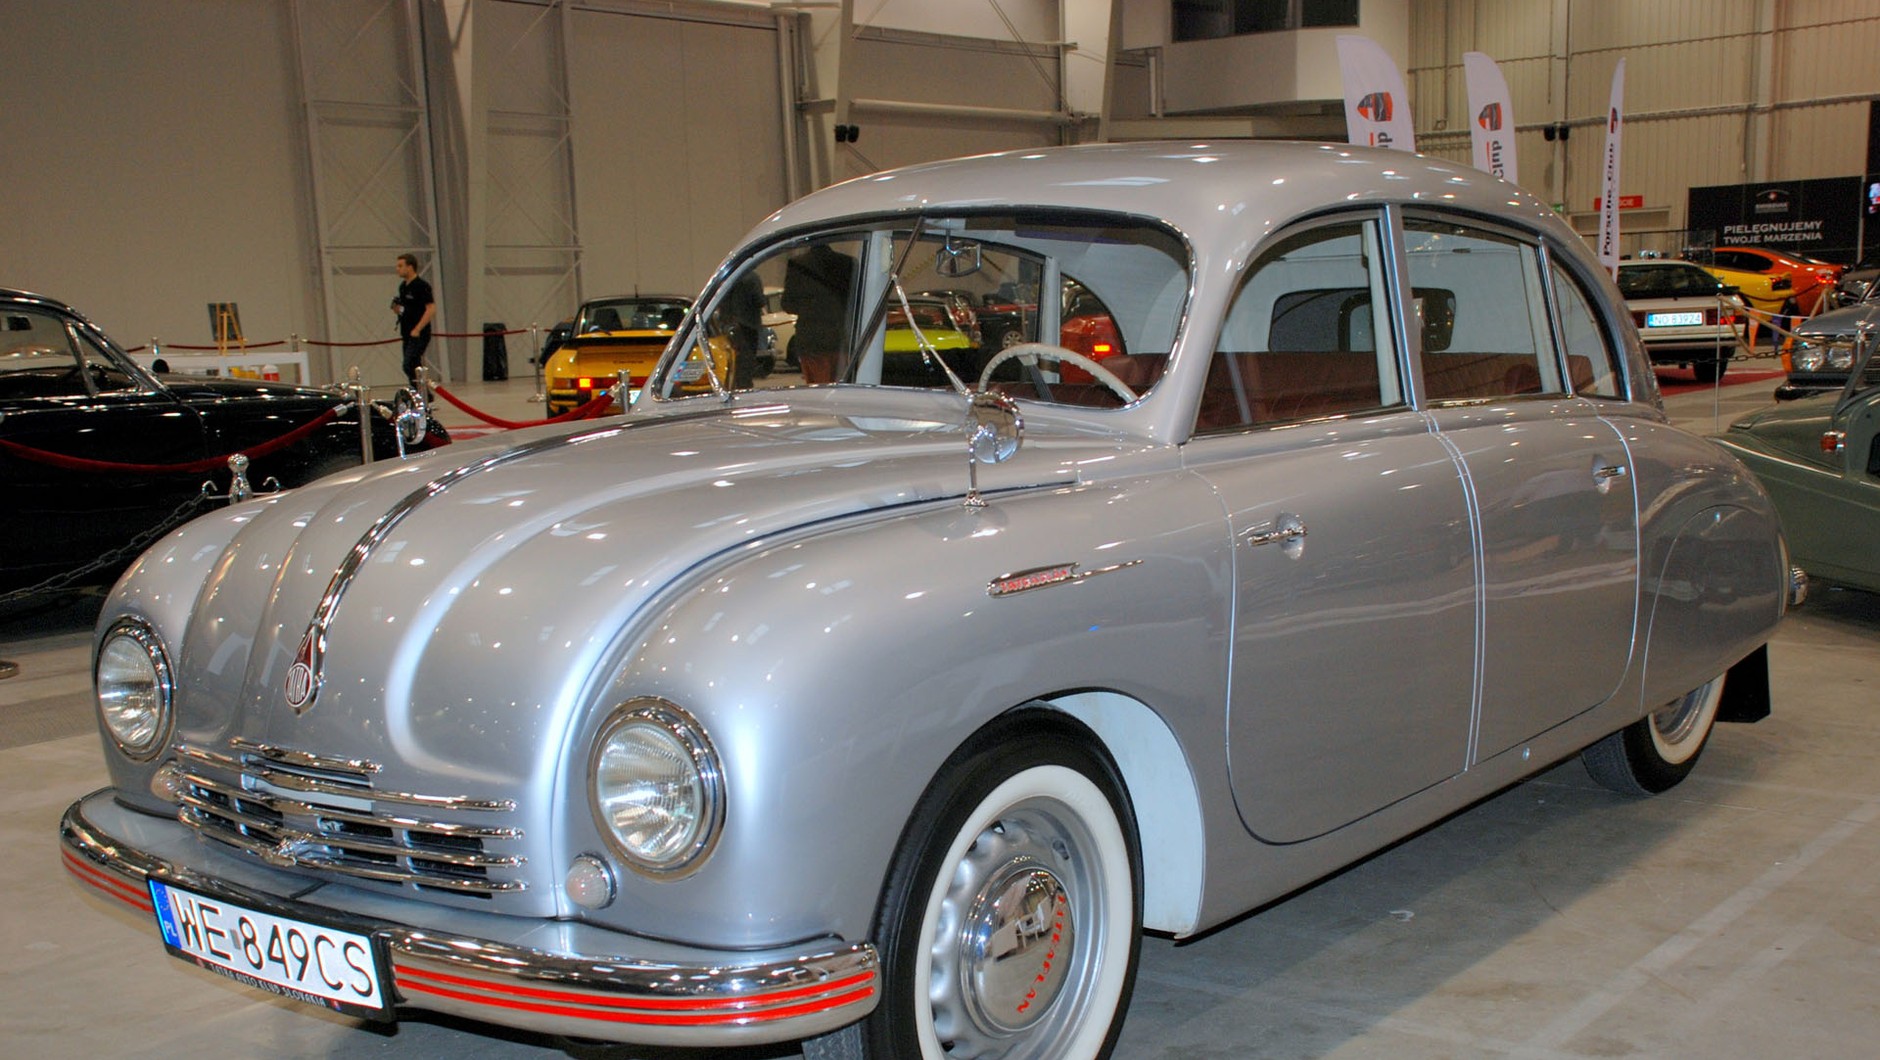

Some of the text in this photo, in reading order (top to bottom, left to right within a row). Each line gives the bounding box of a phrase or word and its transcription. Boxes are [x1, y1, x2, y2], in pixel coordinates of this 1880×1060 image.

[1603, 190, 1613, 256] Porsche
[1723, 220, 1823, 234] PIELĘGNUJEMY
[1723, 232, 1823, 245] TWOJE MARZENIA
[165, 920, 178, 938] PL
[172, 891, 373, 998] WE 849CS
